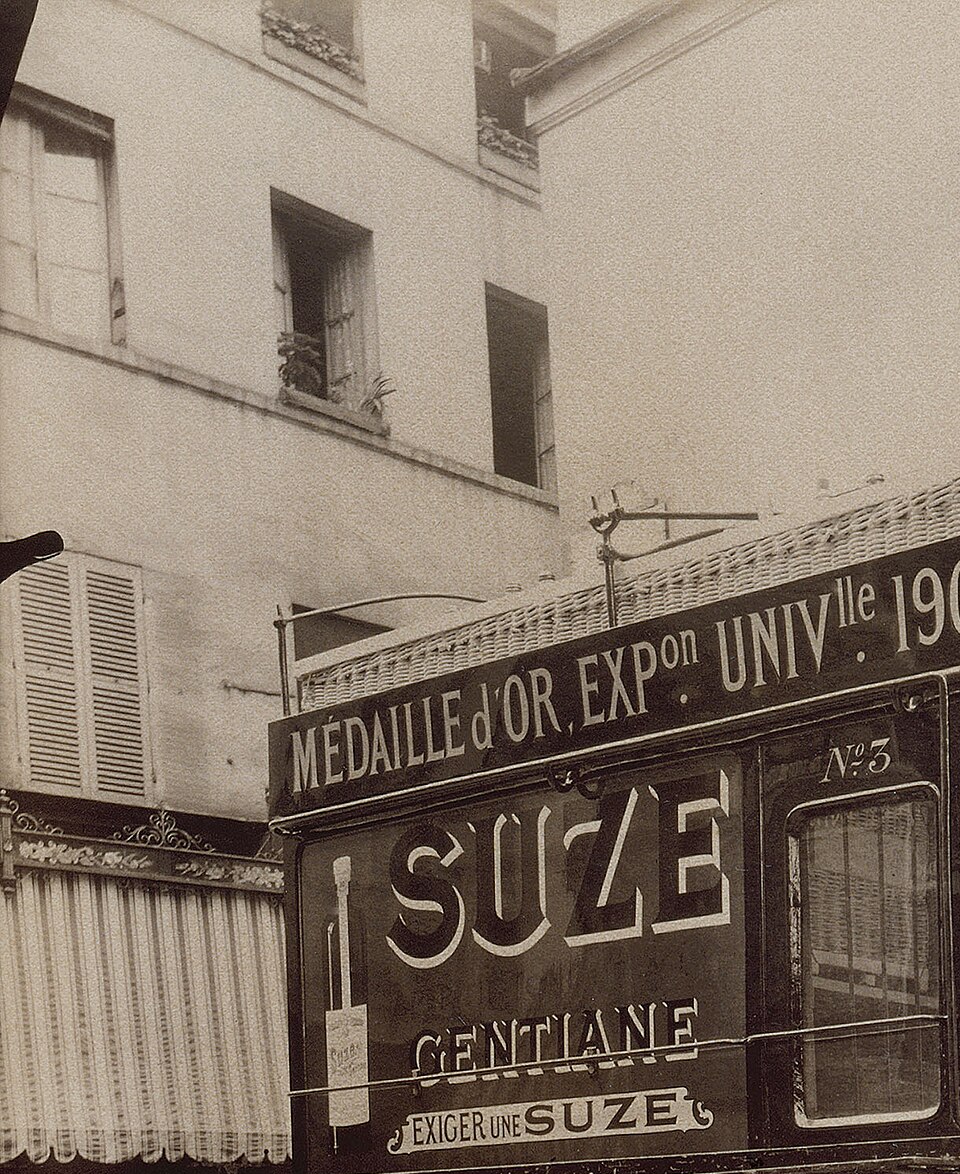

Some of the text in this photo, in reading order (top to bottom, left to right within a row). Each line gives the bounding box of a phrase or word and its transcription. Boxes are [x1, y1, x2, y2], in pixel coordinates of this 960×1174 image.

[290, 689, 465, 793] MÉDAILLE
[868, 737, 892, 774] 3
[386, 766, 731, 969] SUZE
[410, 998, 699, 1088] GENTIANE
[412, 1092, 678, 1146] EXIGER UNE SUZE
